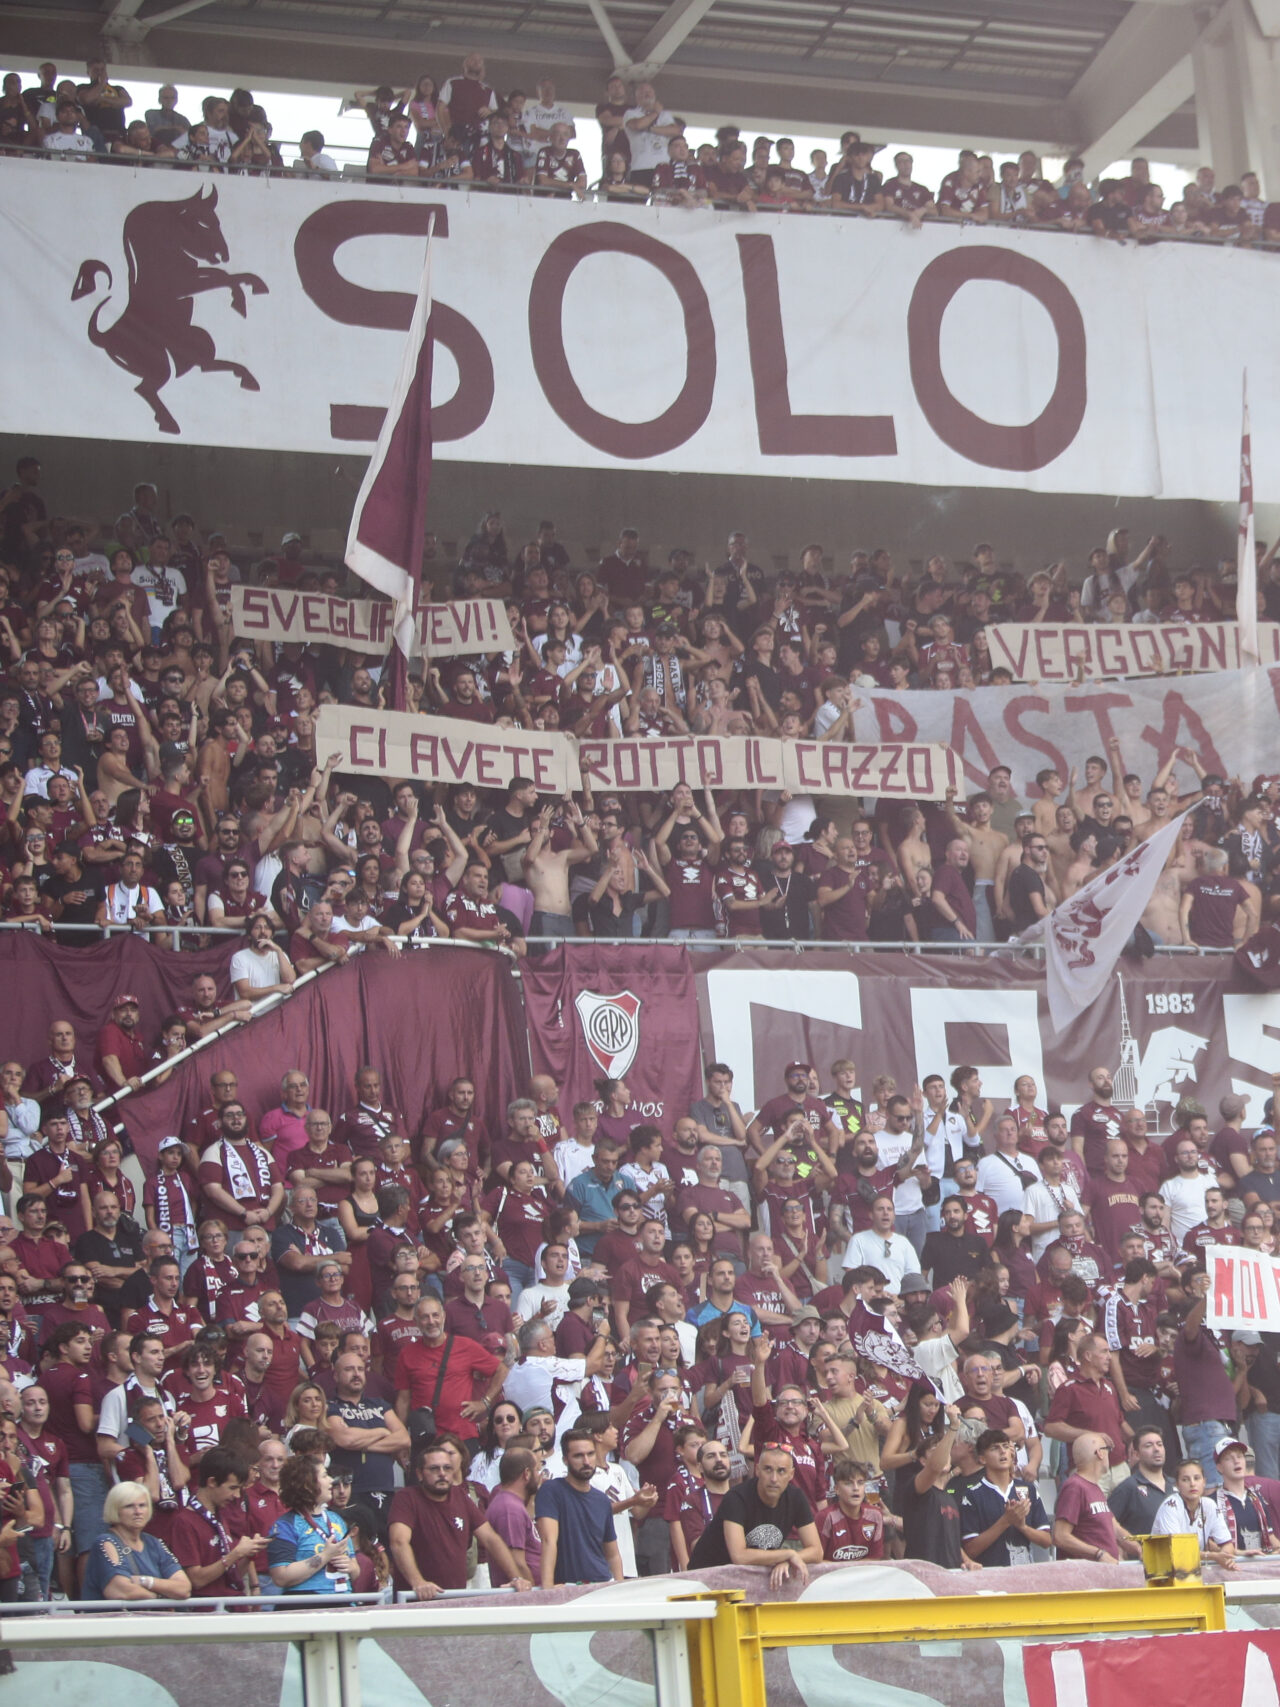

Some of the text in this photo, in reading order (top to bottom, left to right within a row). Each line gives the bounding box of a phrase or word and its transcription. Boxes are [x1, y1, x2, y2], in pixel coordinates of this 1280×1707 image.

[294, 200, 1087, 472] SOLO
[350, 725, 386, 768] CI
[410, 734, 557, 792] AVETE
[578, 739, 723, 787] ROTTO
[745, 741, 777, 784] IL
[171, 847, 192, 890] TORINO
[1146, 992, 1196, 1014] 1983
[157, 1185, 171, 1238] ORINO
[1213, 1258, 1268, 1319] NOI
[833, 1546, 868, 1560] Beretta
